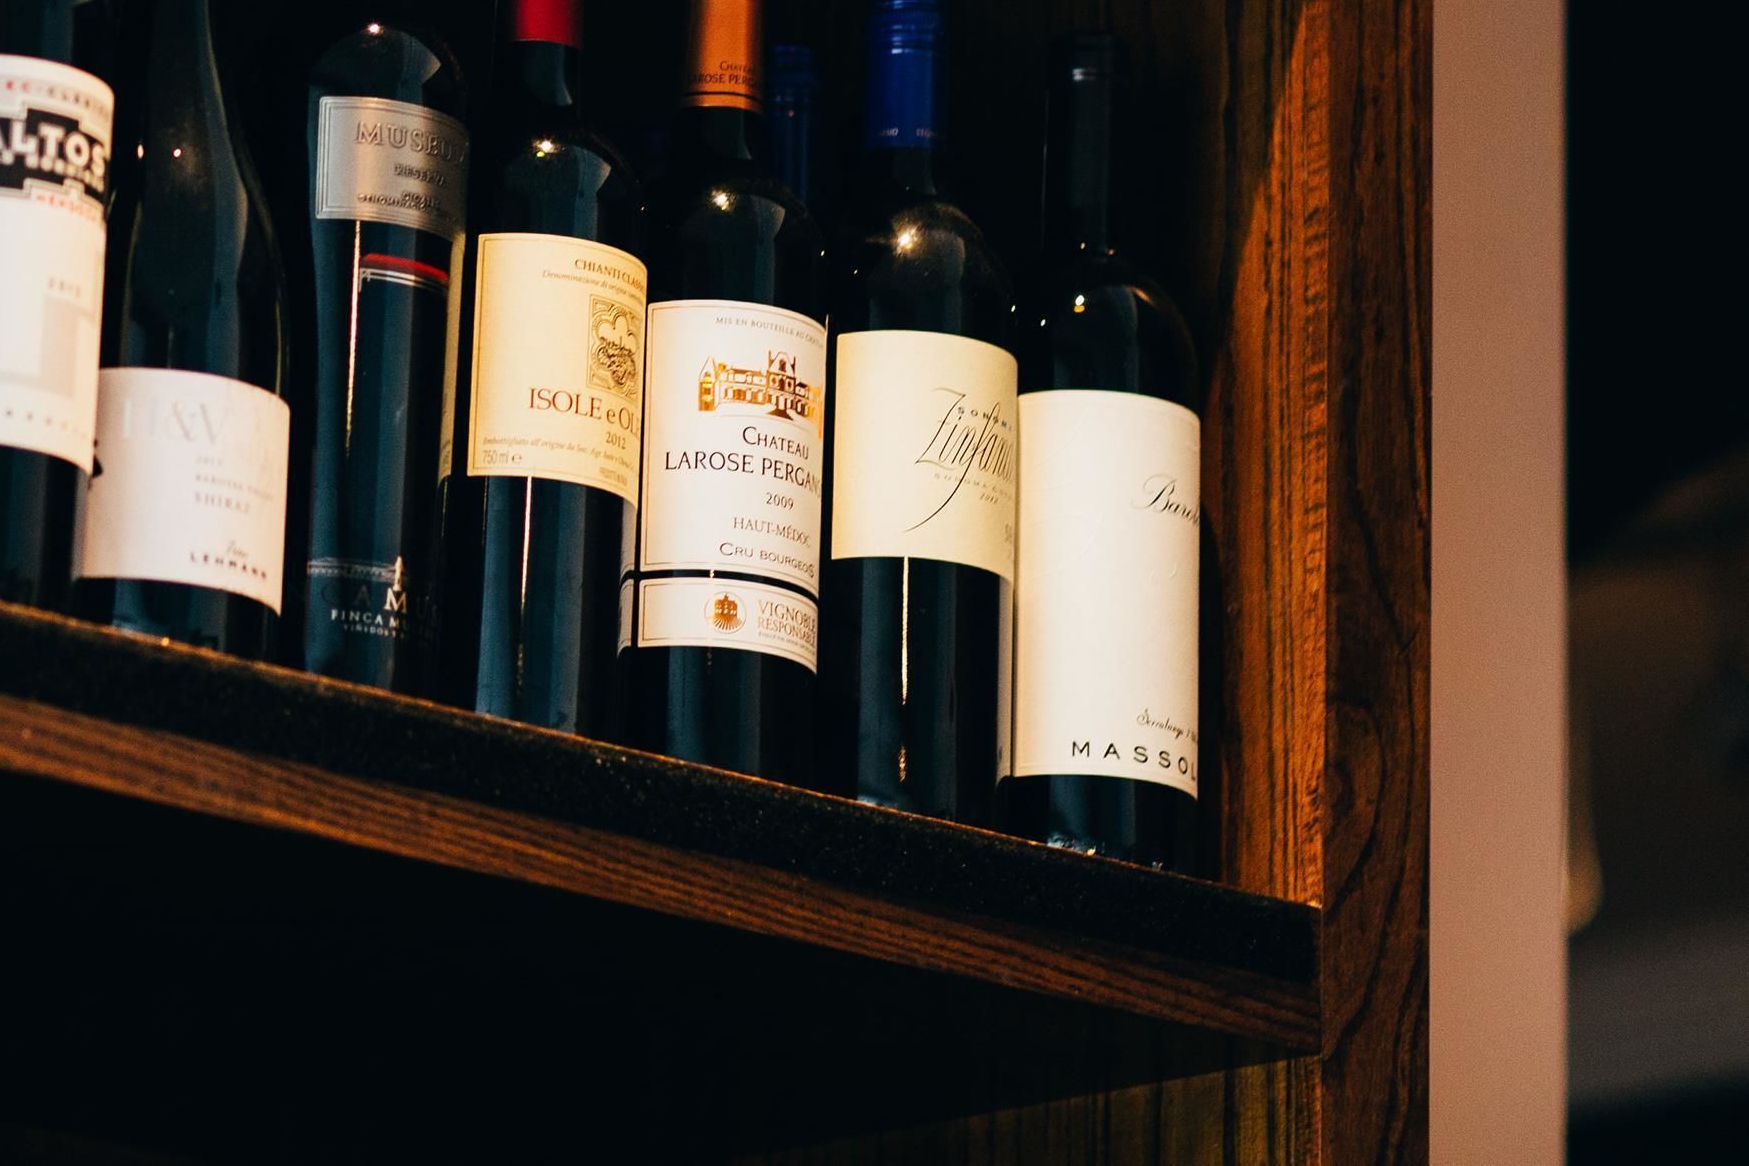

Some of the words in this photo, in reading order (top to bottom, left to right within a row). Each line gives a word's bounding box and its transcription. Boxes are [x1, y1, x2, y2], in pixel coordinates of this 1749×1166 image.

[354, 121, 466, 162] MUSEU
[529, 387, 603, 421] ISOLE
[606, 408, 616, 424] e
[606, 431, 627, 450] 2012
[742, 426, 809, 460] CHATEAU
[482, 449, 497, 465] 750
[665, 450, 755, 474] LAROSE
[765, 491, 795, 510] 2009
[719, 542, 754, 558] CRU
[330, 608, 384, 627] FINCA
